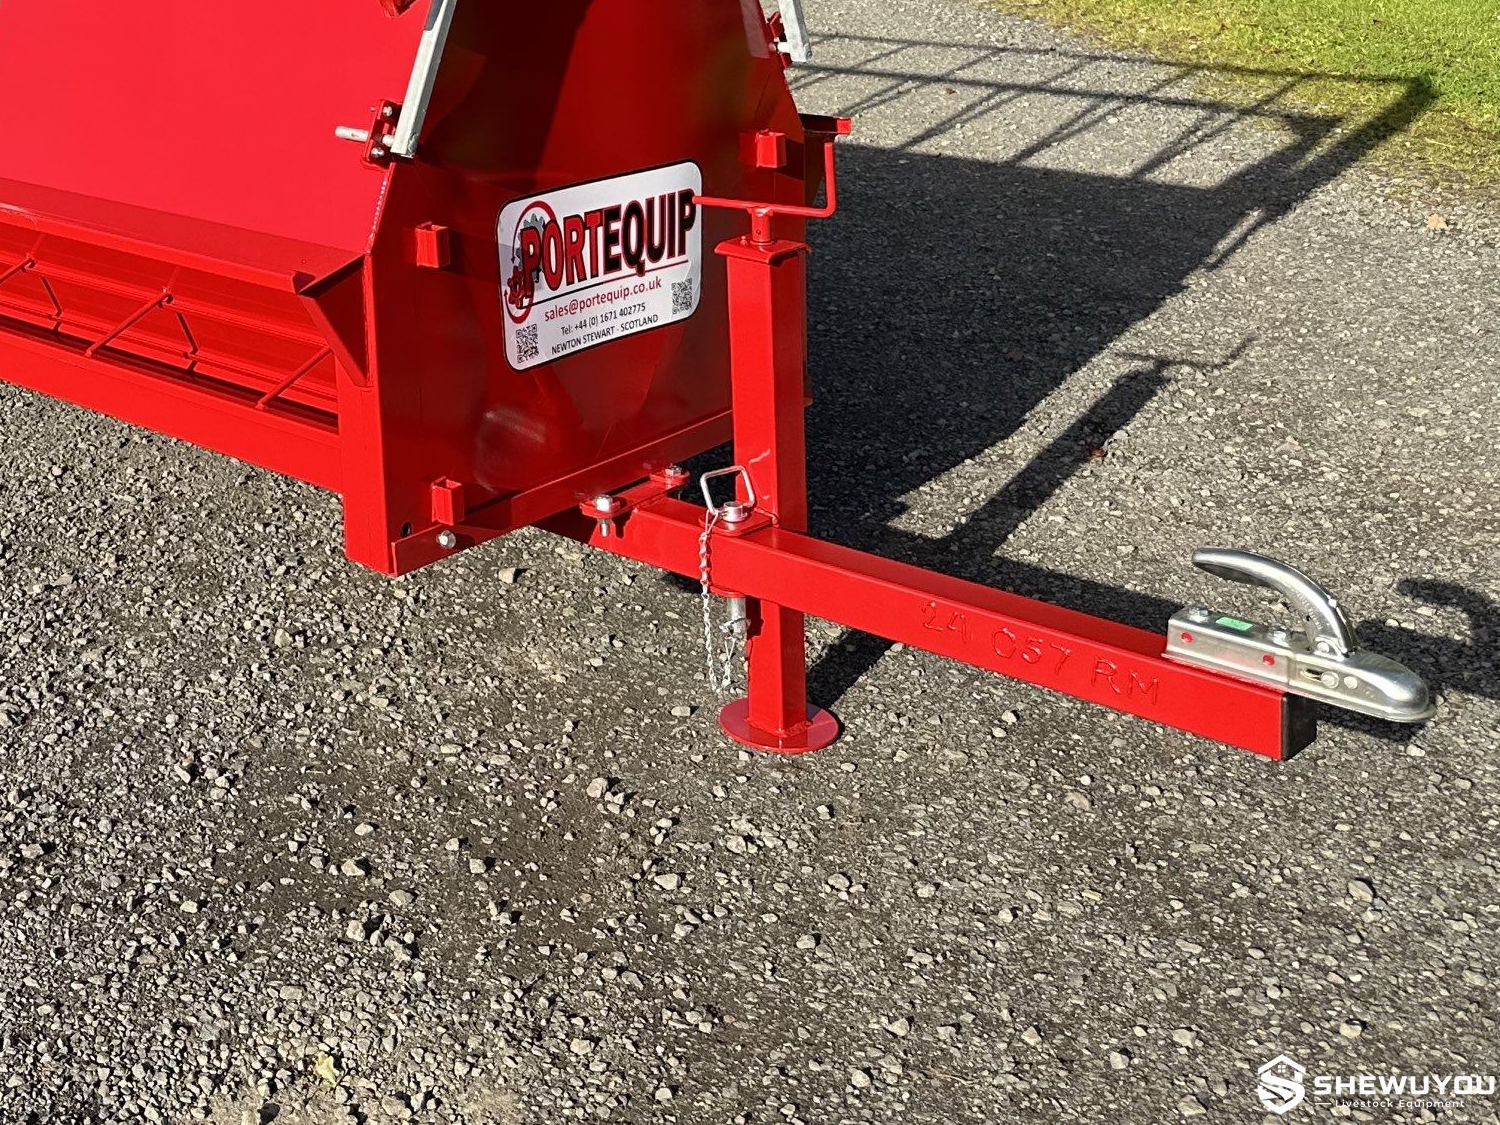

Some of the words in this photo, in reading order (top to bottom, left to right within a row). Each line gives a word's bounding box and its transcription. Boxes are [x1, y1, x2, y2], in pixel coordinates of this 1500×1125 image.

[520, 188, 697, 299] PORTEQUIP
[544, 276, 662, 322] sales@portequip.co.uk
[560, 324, 573, 336] Tel:
[574, 319, 588, 331] +44
[588, 315, 599, 328] (0)
[600, 310, 617, 324] 1671
[619, 302, 646, 317] 402775
[551, 338, 582, 355] NEWTON
[582, 326, 615, 344] STEWART
[620, 314, 659, 332] SCOTLAND
[1091, 657, 1161, 706] RM
